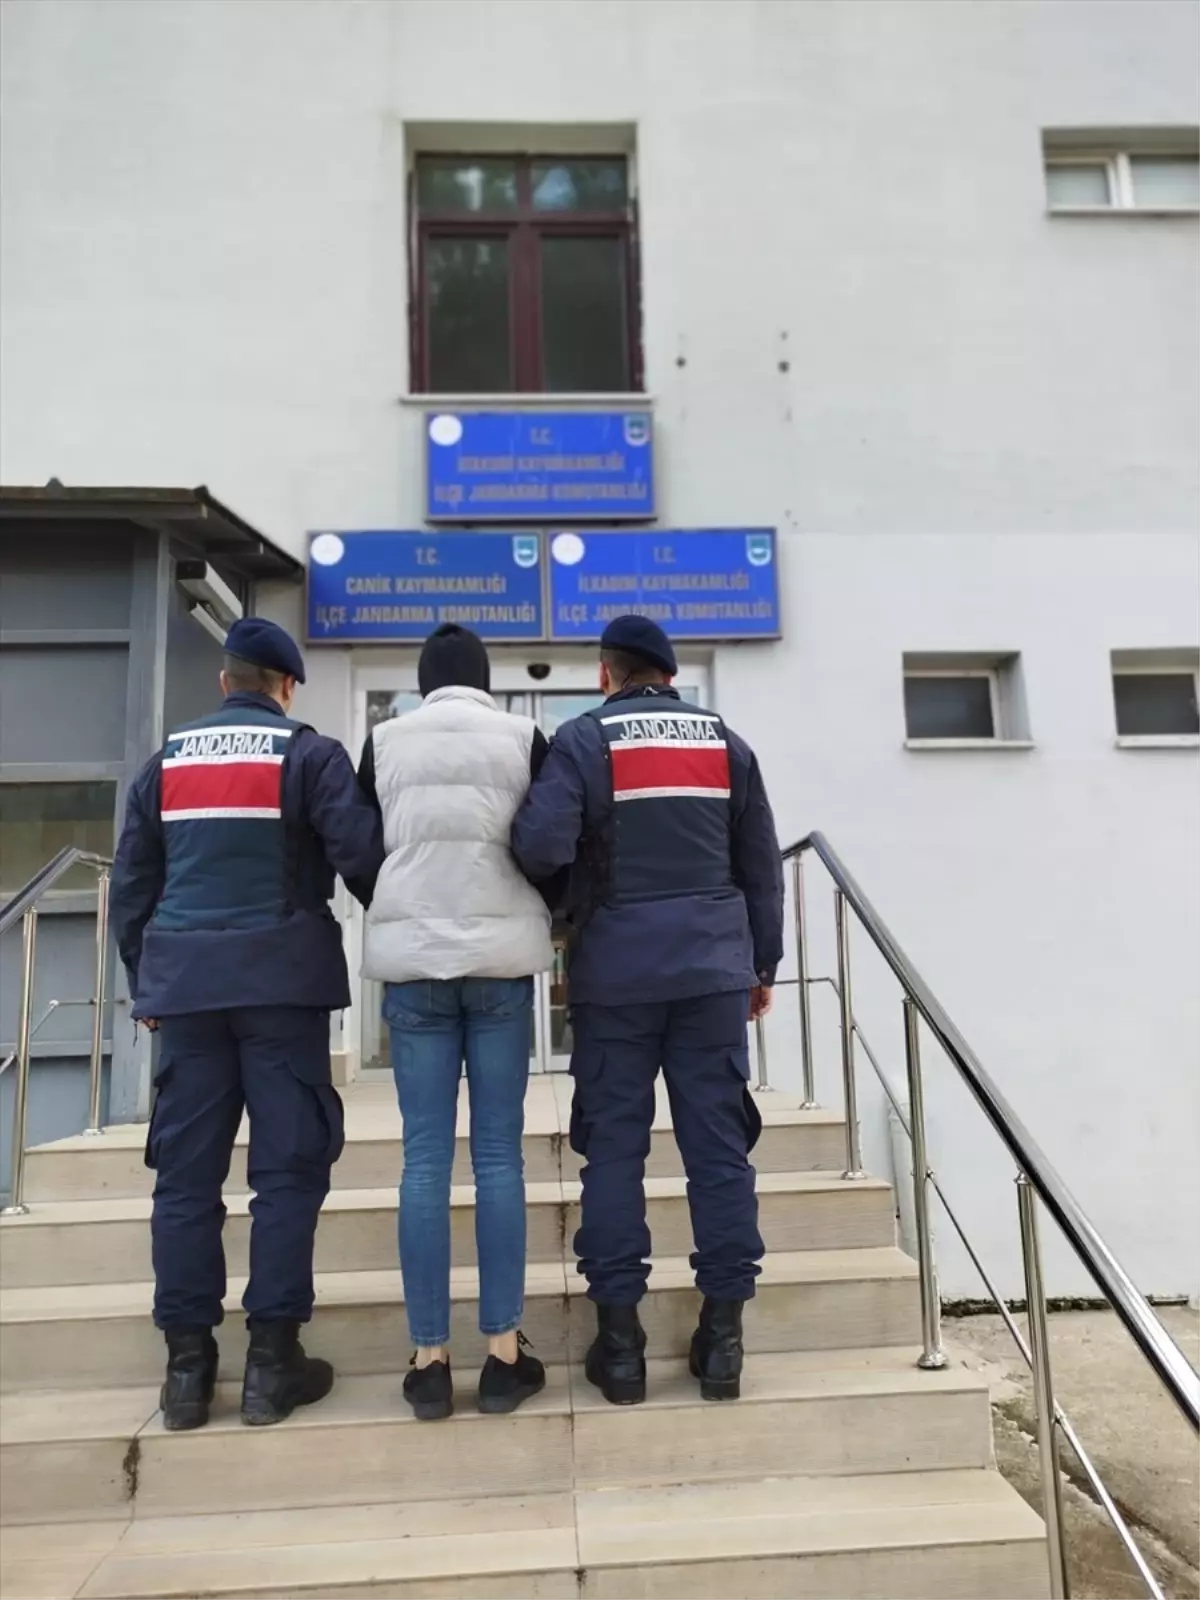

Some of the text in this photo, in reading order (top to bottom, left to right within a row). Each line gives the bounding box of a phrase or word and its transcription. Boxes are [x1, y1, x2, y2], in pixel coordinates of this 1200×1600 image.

[415, 547, 441, 565] T.C.
[345, 573, 507, 594] CANİK KAYMAKAMLIĞI
[316, 601, 536, 627] İLÇE JANDARMA KOMUTANLIĞI
[559, 599, 588, 625] İLÇE
[620, 719, 718, 741] JANDARMA
[174, 732, 273, 758] JANDARMA
